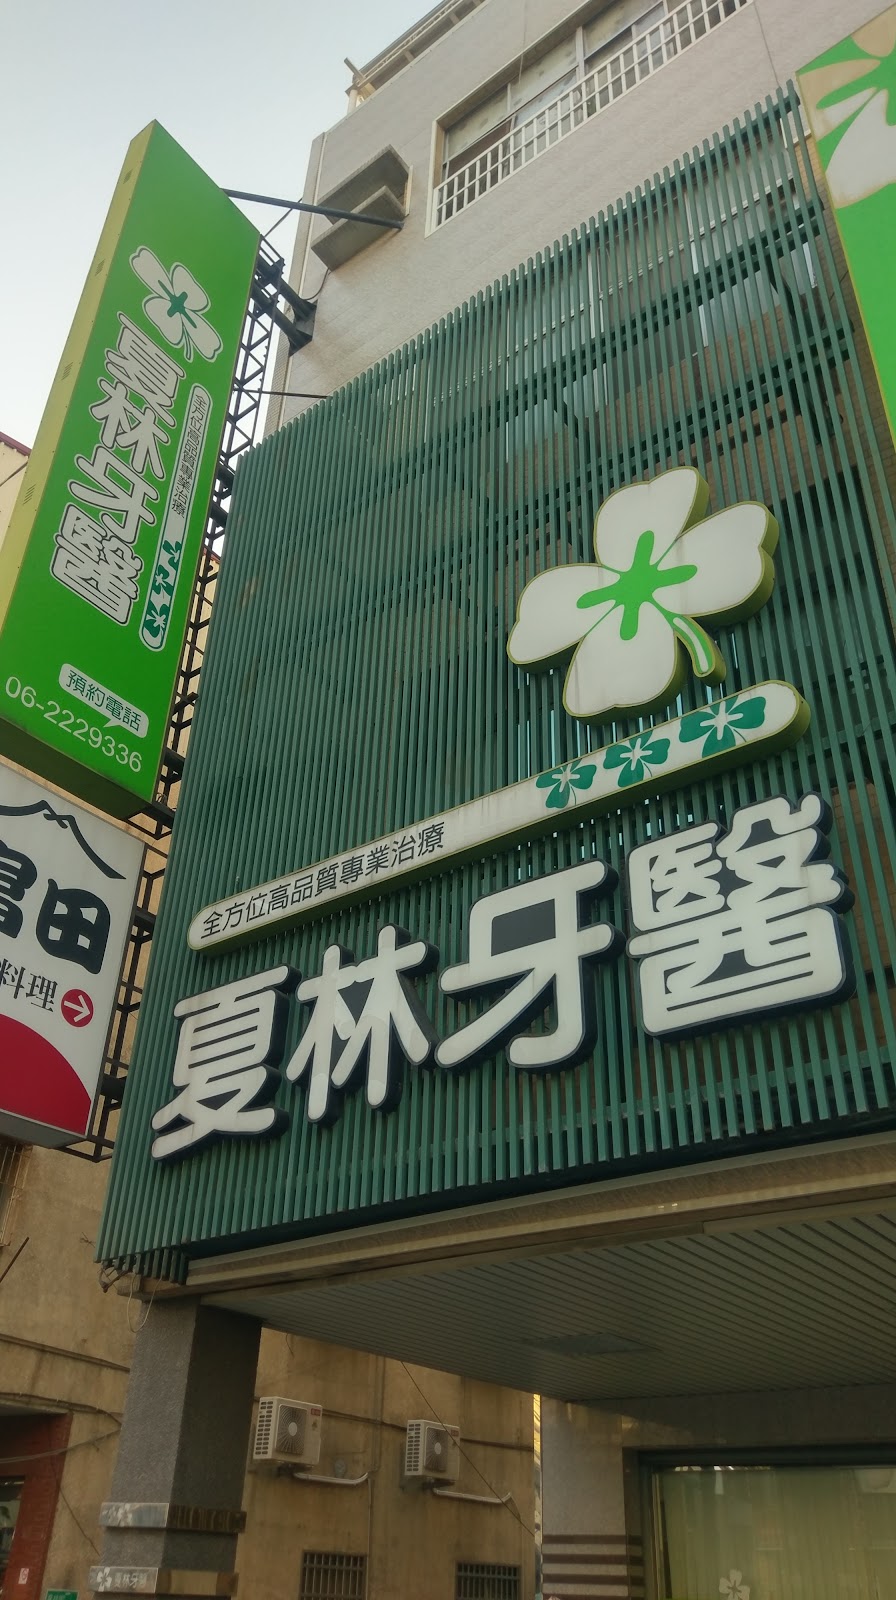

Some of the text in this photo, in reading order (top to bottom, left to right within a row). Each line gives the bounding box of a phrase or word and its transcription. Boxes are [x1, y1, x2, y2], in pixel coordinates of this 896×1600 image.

[51, 311, 185, 625] 夏林牙醫
[171, 394, 208, 519] 全方位高品質專業治療
[5, 676, 142, 773] 06-2229336
[66, 669, 141, 732] 預約電話
[200, 821, 445, 940] 全方位高品質專業治療
[0, 958, 58, 1013] 料理
[150, 792, 841, 1162] 夏林牙醫
